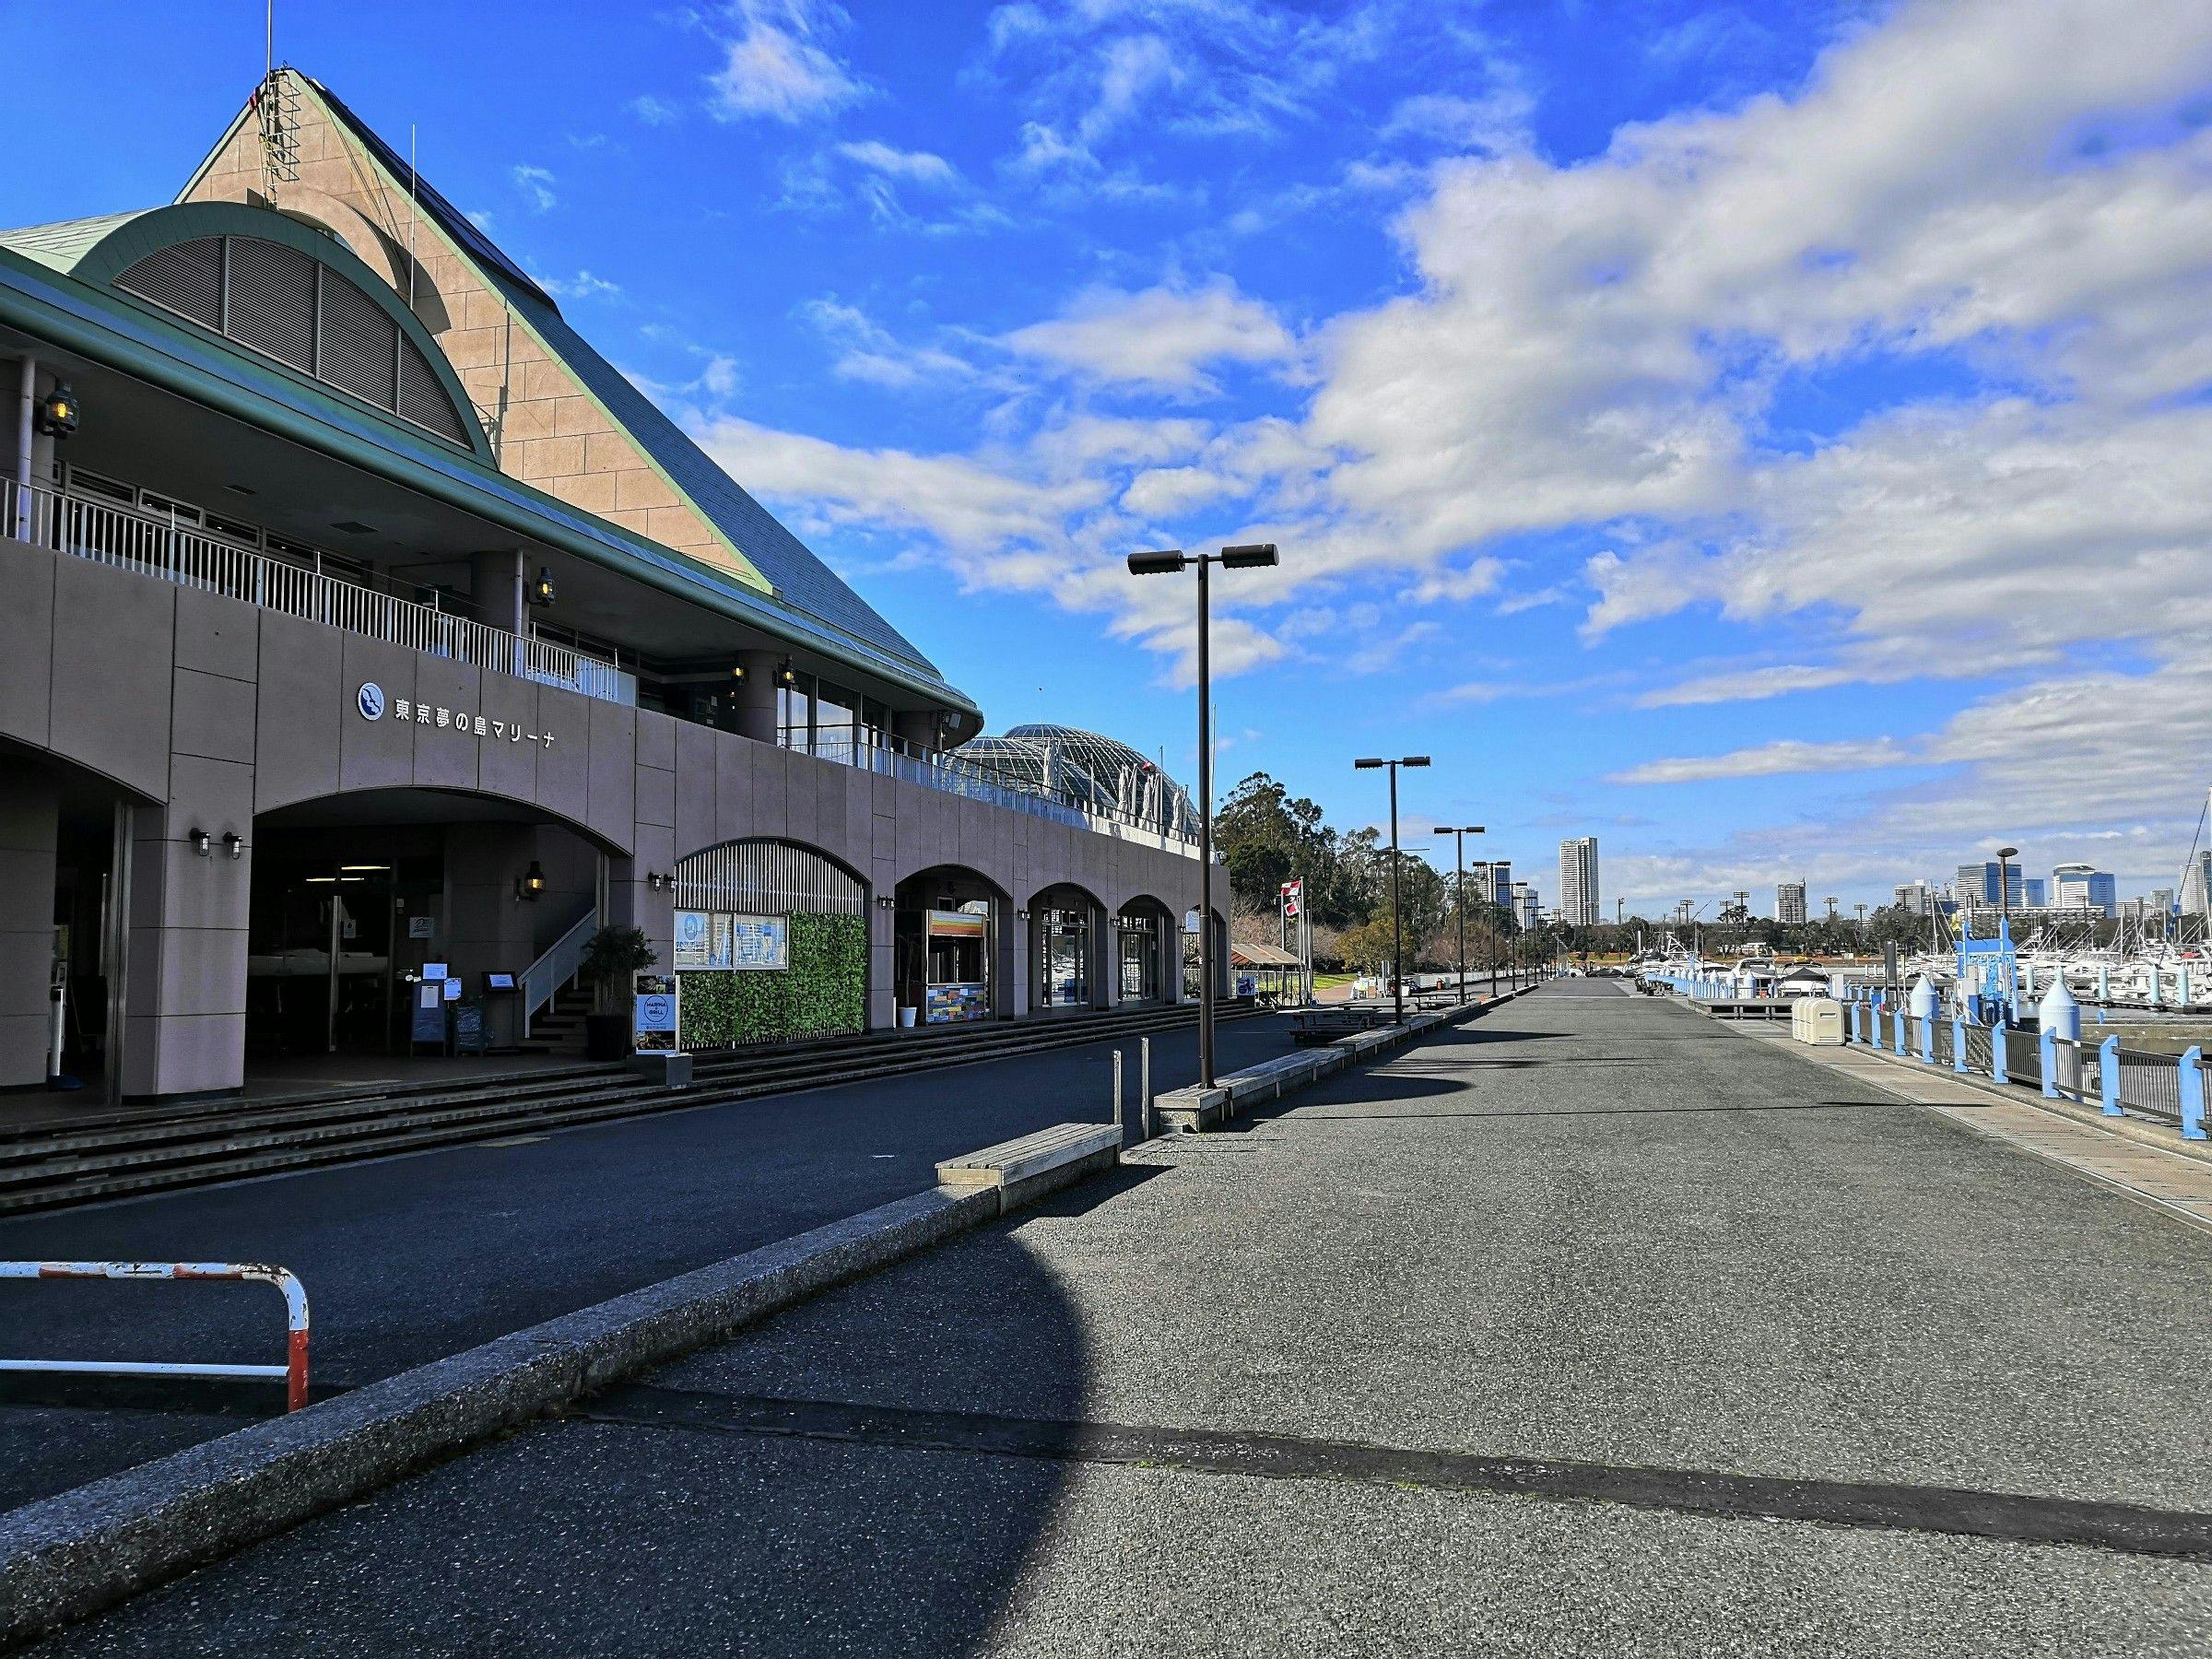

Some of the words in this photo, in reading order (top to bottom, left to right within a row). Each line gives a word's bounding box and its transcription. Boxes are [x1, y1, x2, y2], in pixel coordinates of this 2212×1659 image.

[394, 699, 555, 748] 東京夢の島マリーナ
